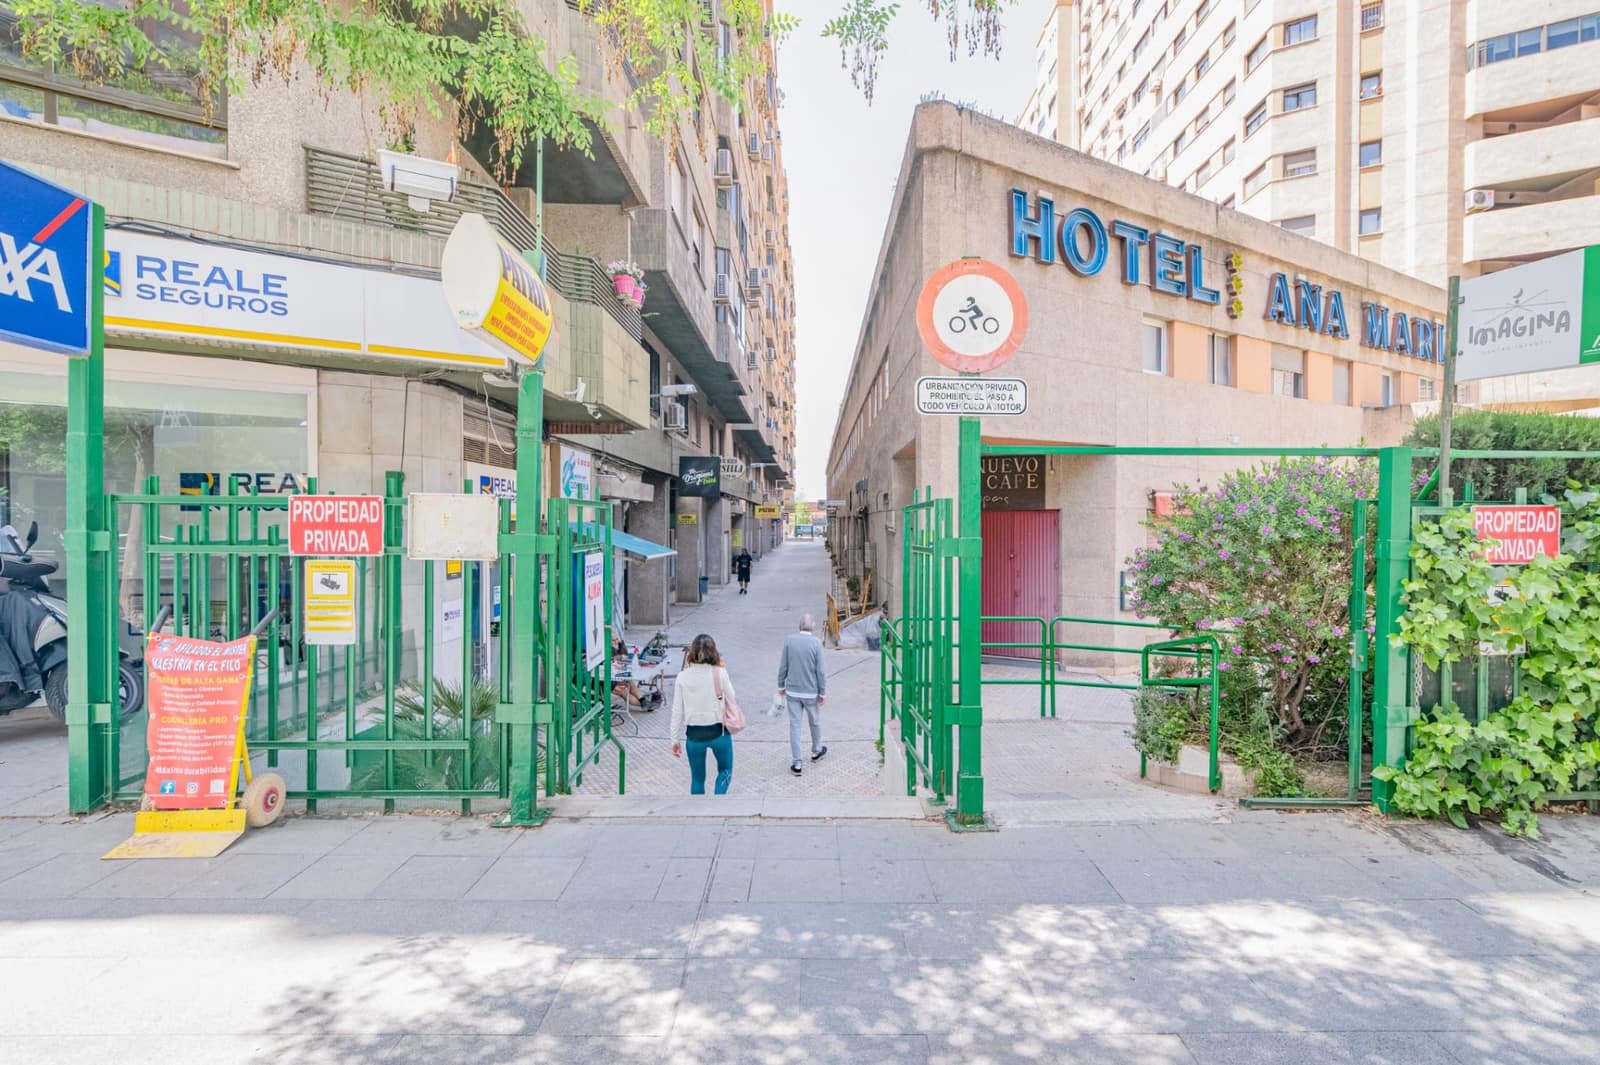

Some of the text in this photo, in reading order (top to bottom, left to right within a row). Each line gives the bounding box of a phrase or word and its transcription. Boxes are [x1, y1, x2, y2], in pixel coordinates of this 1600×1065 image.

[0, 231, 73, 314] XA
[1008, 188, 1220, 305] HOTEL
[1263, 272, 1349, 340] ANA
[136, 254, 288, 298] REALE
[136, 283, 288, 316] SEGUROS
[985, 383, 1018, 391] PRIVADA
[986, 393, 1006, 401] PASO
[922, 402, 944, 410] TODO
[946, 402, 984, 410] VEHCULO
[292, 501, 380, 524] PROPIEDAD
[1475, 511, 1557, 532] PROPIEDAD
[304, 530, 369, 552] PRIVADA
[1486, 538, 1545, 560] PRIVADA
[193, 659, 206, 672] EN
[207, 660, 218, 672] EL
[221, 659, 240, 672] FILO
